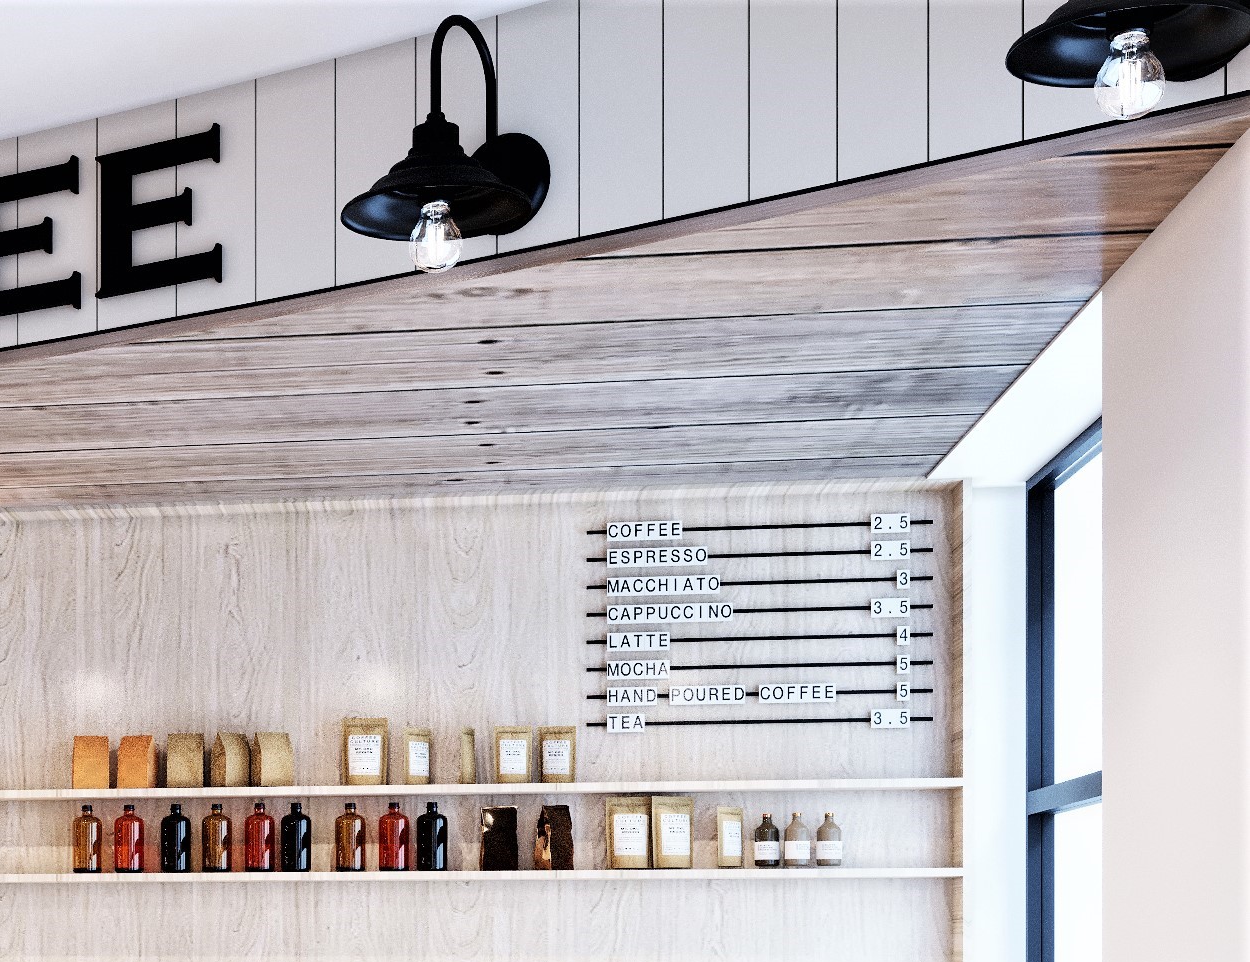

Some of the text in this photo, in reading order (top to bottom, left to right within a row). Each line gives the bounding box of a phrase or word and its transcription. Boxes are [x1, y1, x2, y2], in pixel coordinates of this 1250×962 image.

[608, 516, 908, 538] COFFEE 2.5
[609, 543, 908, 565] ESPRESSO 2.5
[607, 571, 908, 594] MACCHIATO 3
[608, 600, 908, 621] CAPPUCCINO 3.5
[609, 628, 908, 649] LATTE 4
[607, 657, 908, 677] MOCHA 5
[608, 684, 908, 703] HAND POURED COFFEE 5
[608, 711, 908, 730] TEA 3.5
